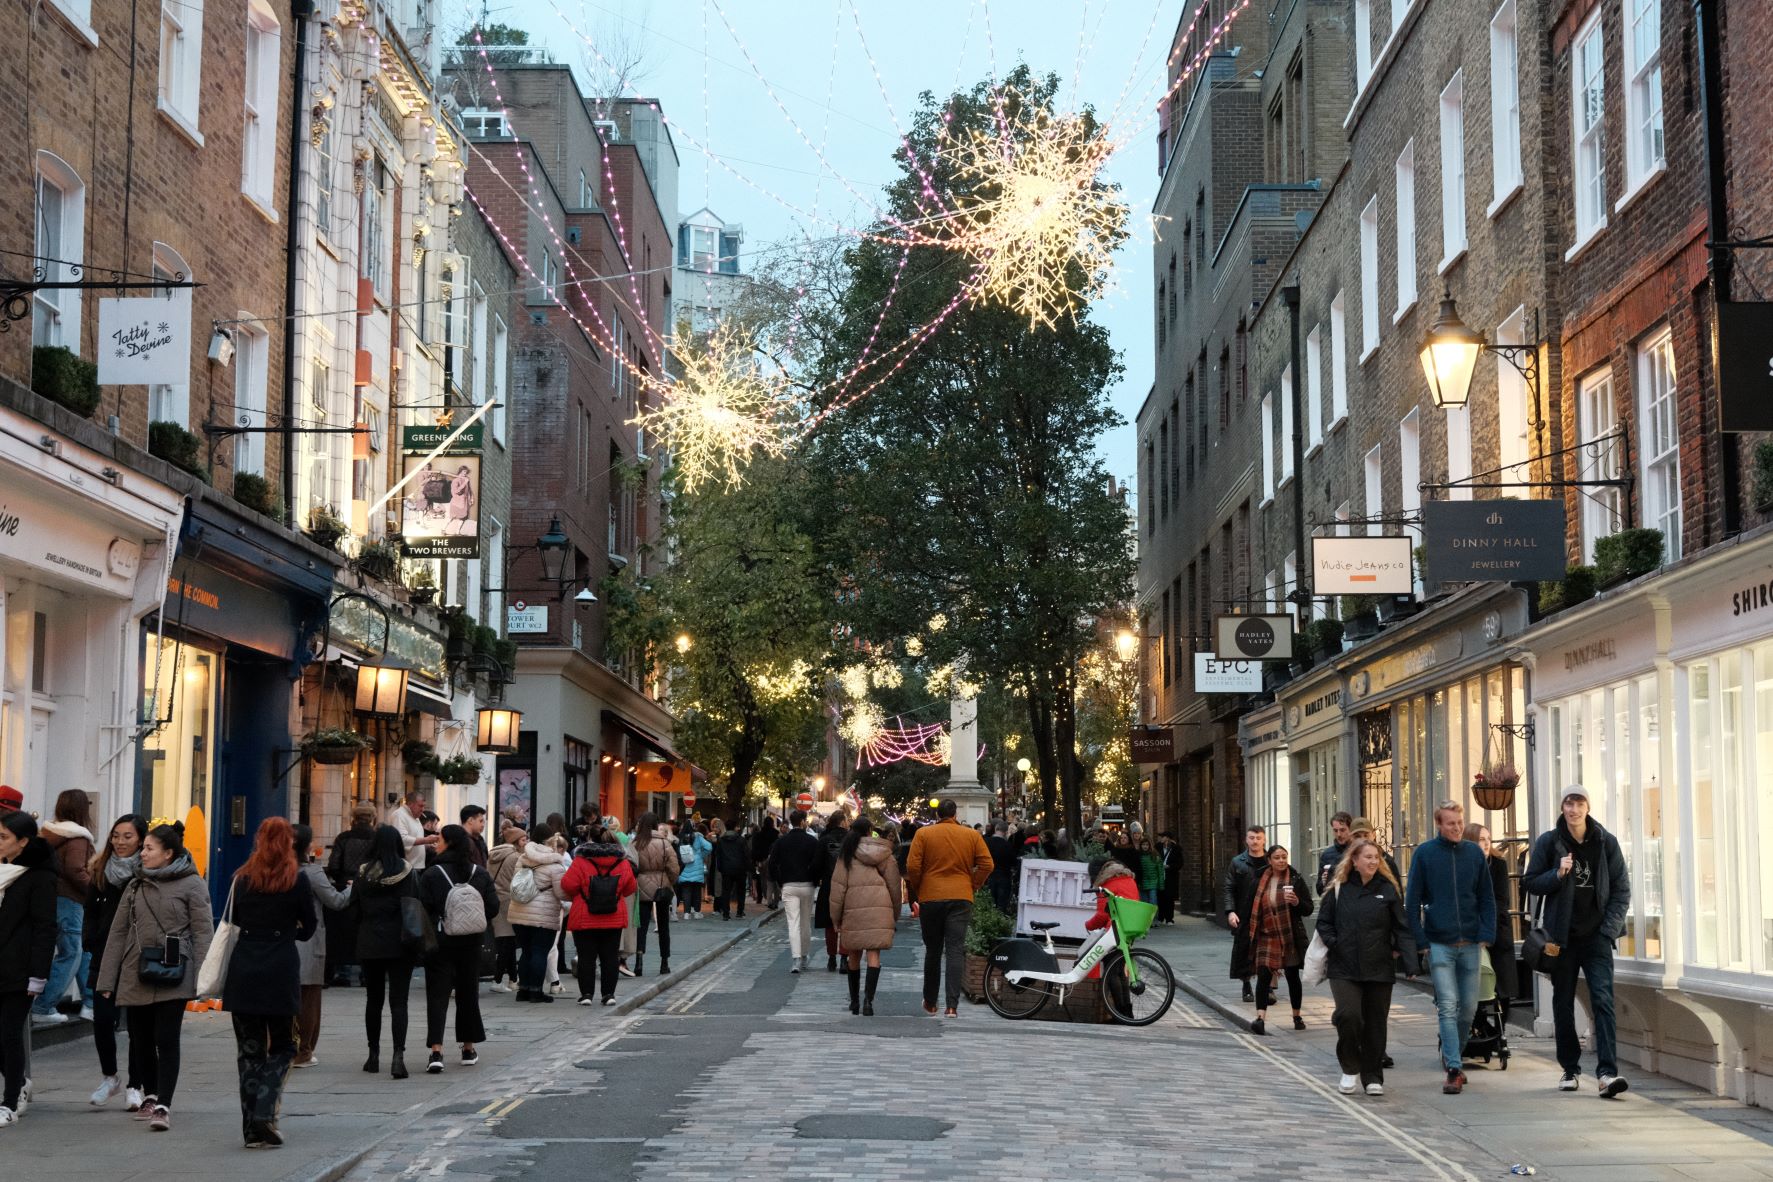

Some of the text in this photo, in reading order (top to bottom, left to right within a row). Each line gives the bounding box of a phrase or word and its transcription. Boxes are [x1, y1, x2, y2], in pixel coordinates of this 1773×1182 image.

[112, 325, 149, 345] Tatty
[126, 335, 172, 357] Devine
[411, 434, 474, 442] GREENE ING
[0, 504, 20, 536] ine
[431, 538, 449, 546] THE
[1453, 538, 1537, 548] DINNY HALL
[408, 547, 472, 555] TWO BREWERS
[1471, 560, 1521, 569] JEWELLERY
[1133, 739, 1171, 747] SASSOON
